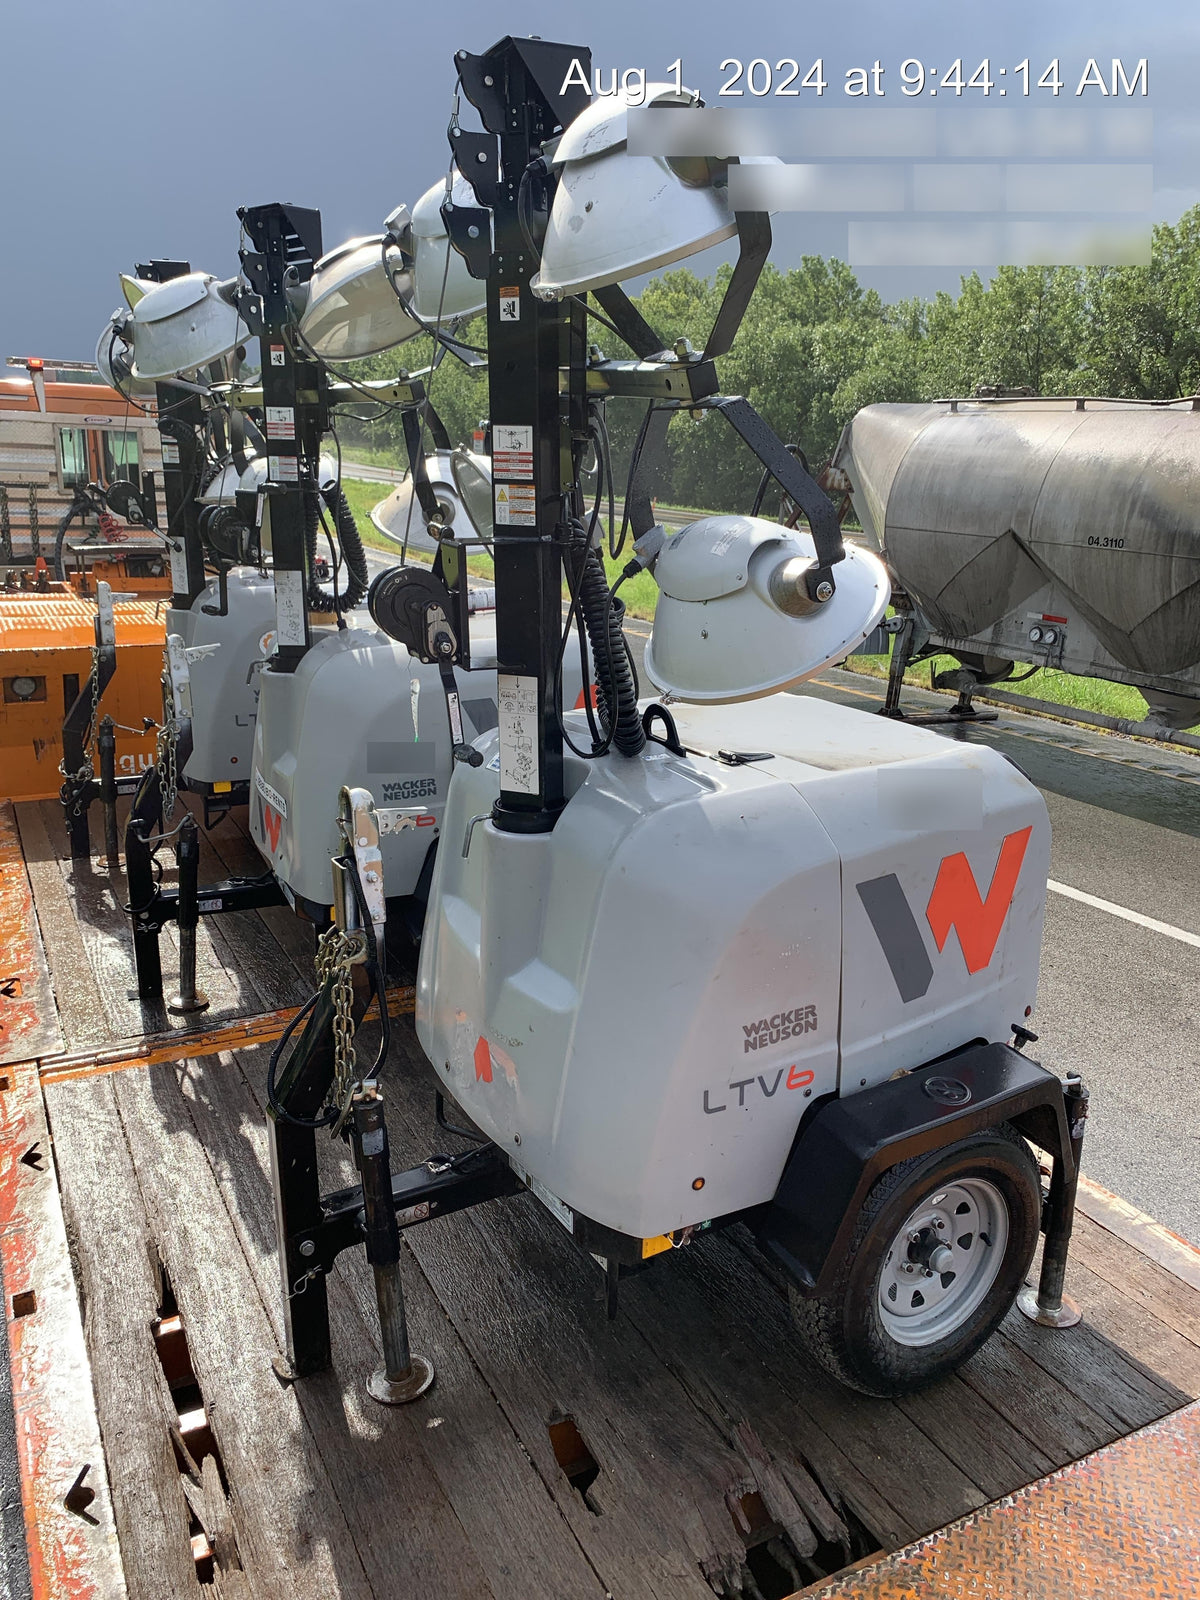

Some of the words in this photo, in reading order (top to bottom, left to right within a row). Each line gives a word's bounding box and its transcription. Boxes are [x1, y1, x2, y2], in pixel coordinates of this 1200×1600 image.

[1087, 535, 1125, 549] 04.3110
[382, 778, 437, 792] WACKER
[383, 787, 437, 801] NEUSON
[742, 1004, 818, 1038] WACKER
[744, 1017, 818, 1053] NEUSON
[703, 1064, 815, 1114] LTV6
